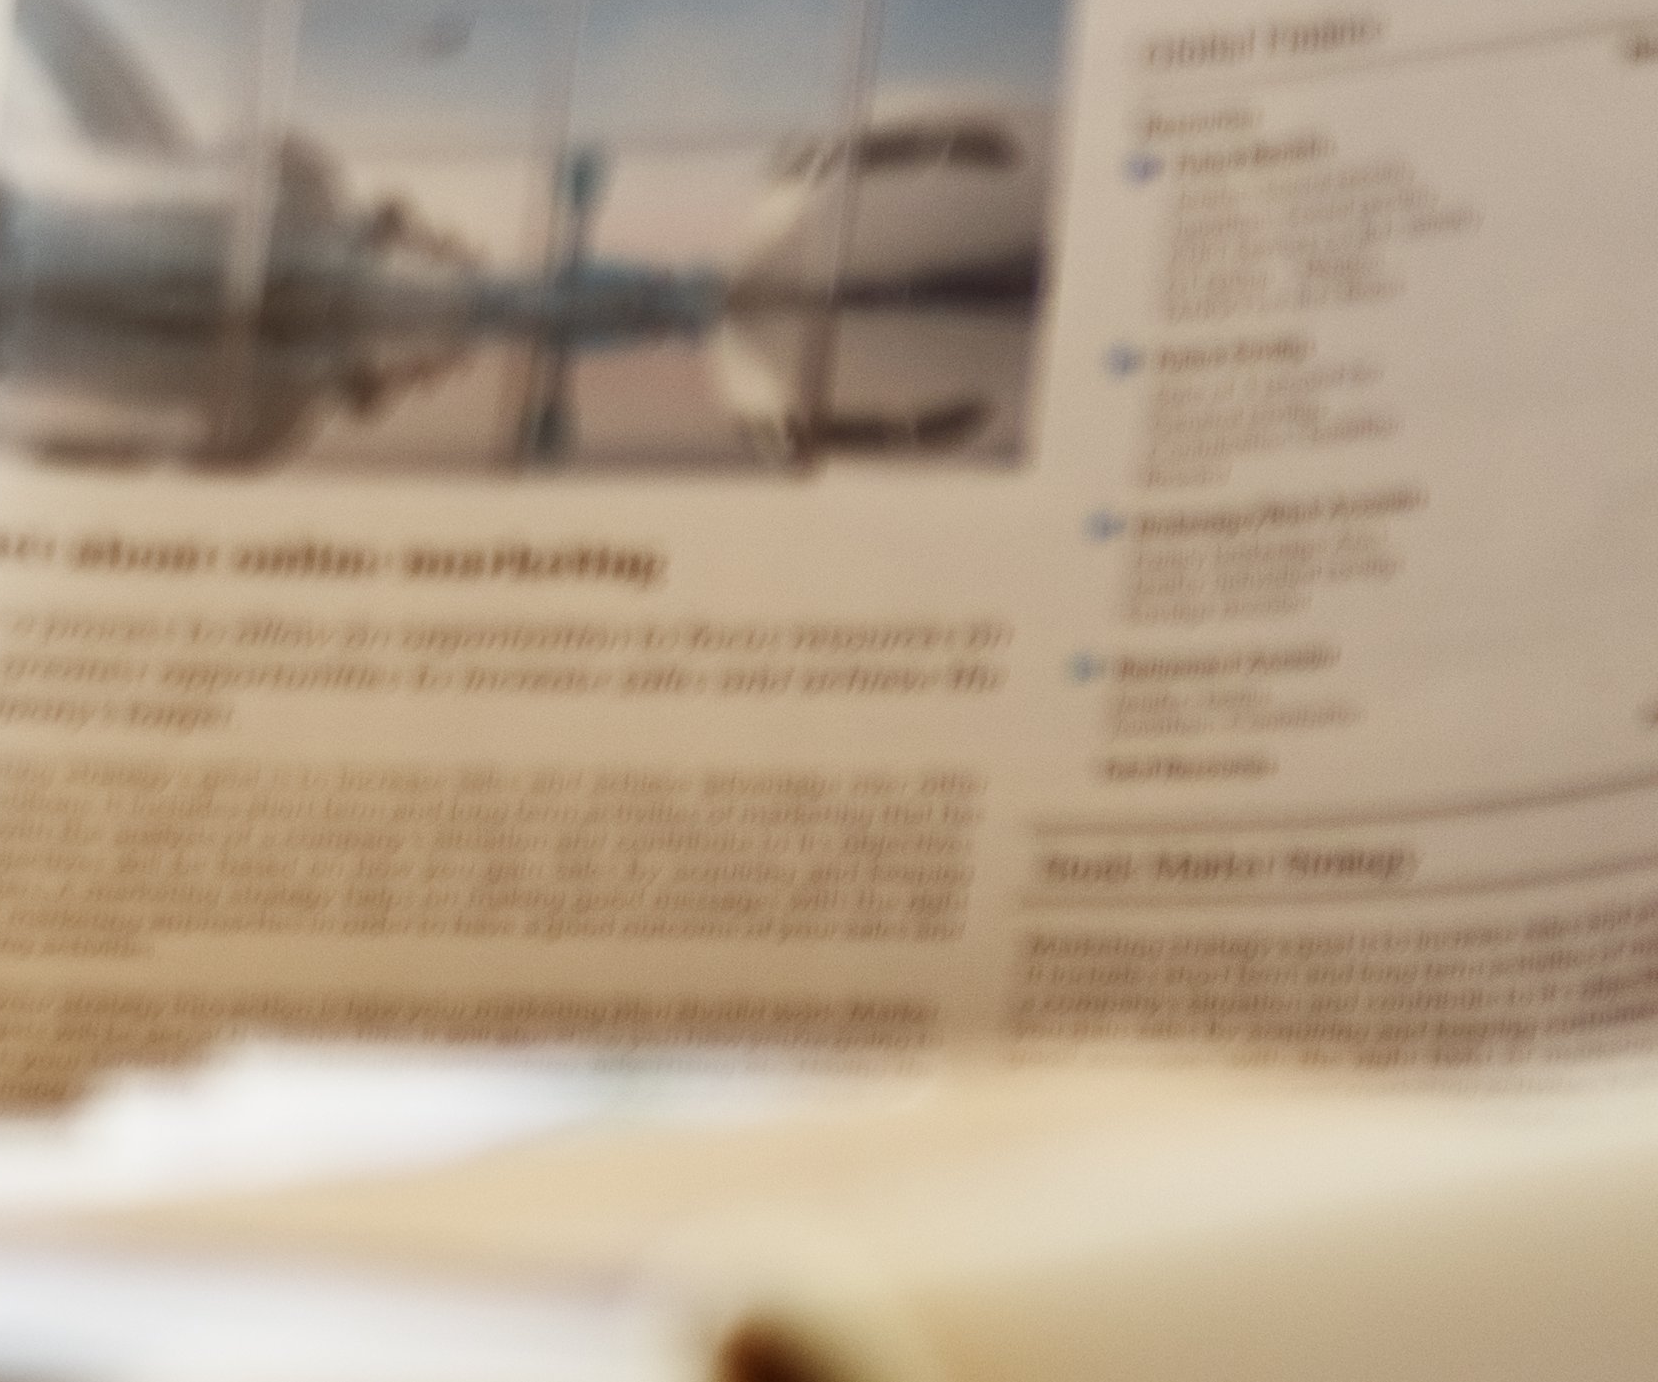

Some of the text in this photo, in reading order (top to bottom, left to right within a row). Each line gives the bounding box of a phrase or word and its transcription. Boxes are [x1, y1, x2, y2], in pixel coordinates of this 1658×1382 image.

[69, 531, 224, 576] about
[232, 534, 394, 580] online
[407, 537, 666, 591] marketing
